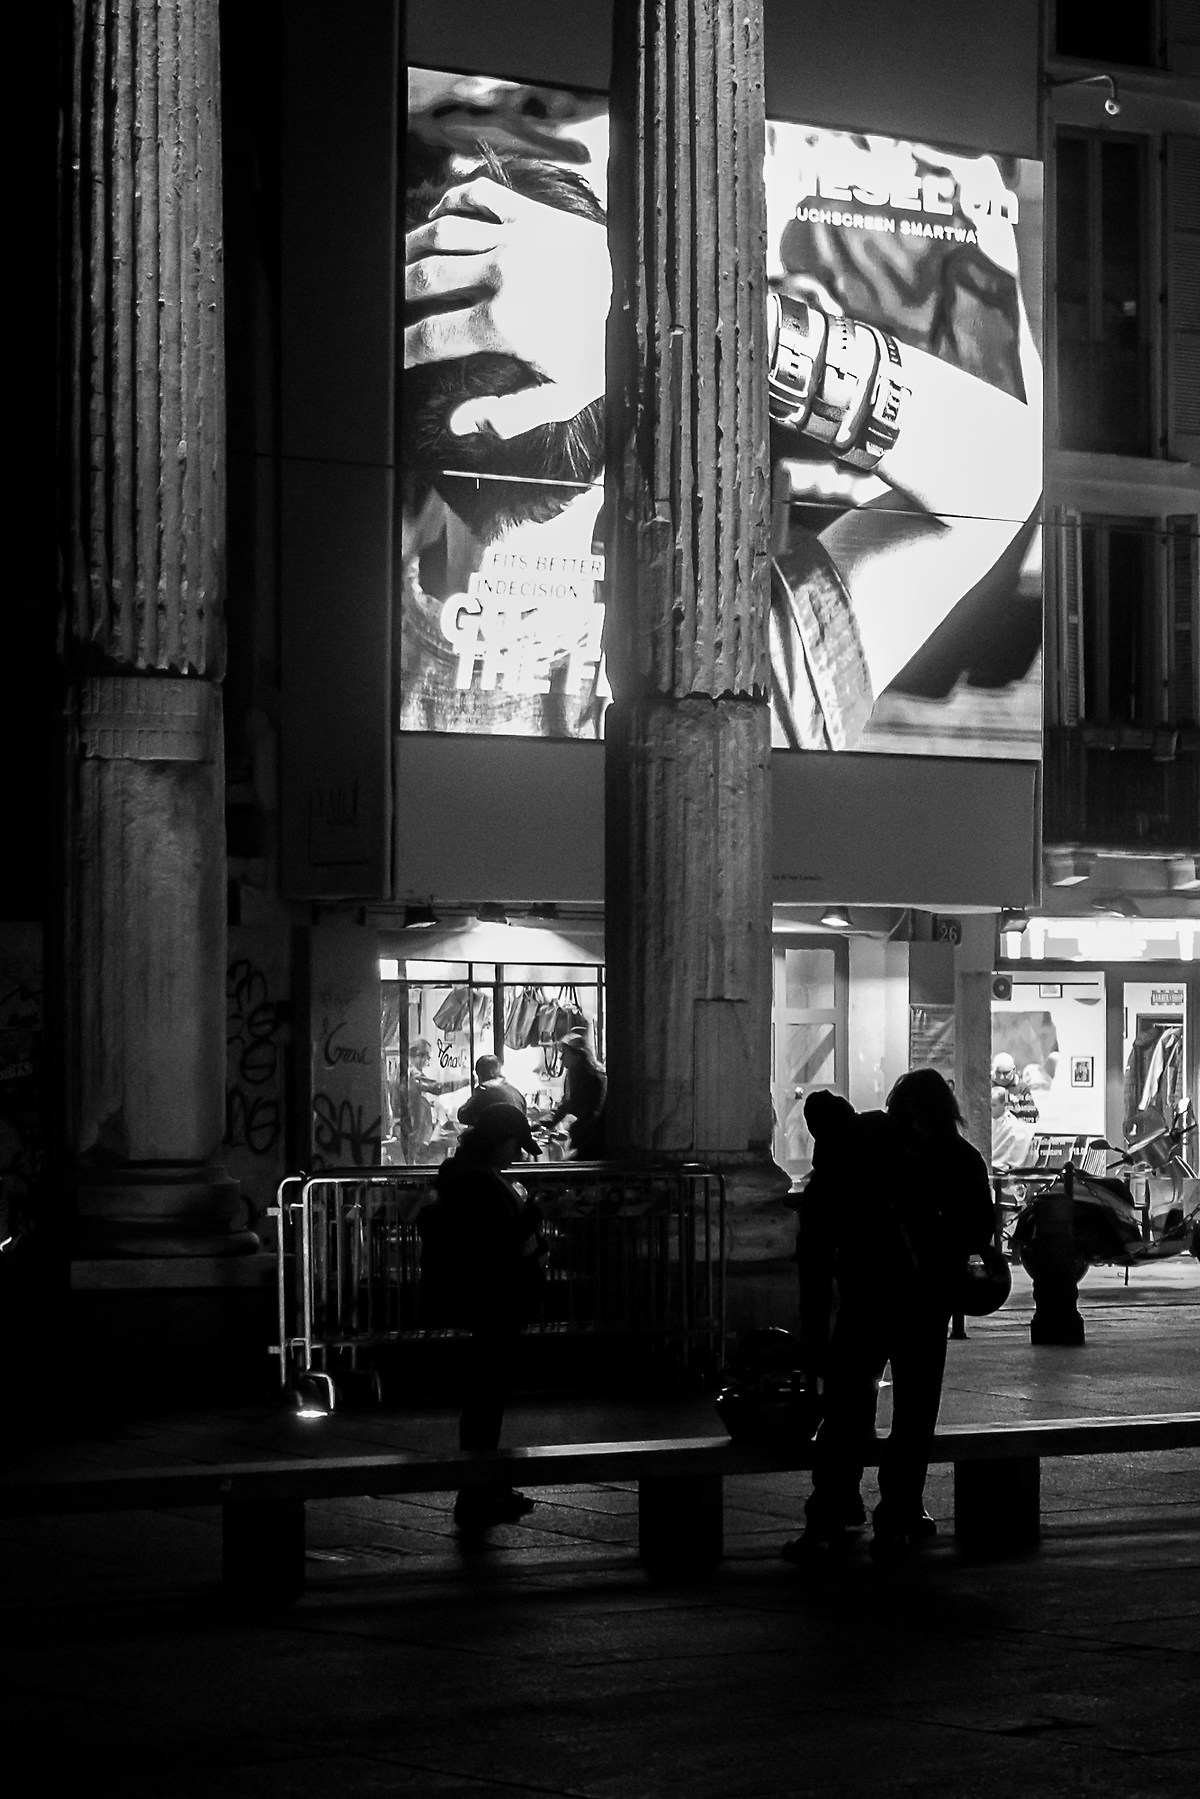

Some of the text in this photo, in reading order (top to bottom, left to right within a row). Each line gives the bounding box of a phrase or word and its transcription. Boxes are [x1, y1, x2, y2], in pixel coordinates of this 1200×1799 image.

[793, 206, 977, 244] UCHSCREEN SMARTWA
[493, 553, 602, 574] FITS BETTER
[476, 579, 578, 599] INDECISION
[939, 923, 958, 943] 26
